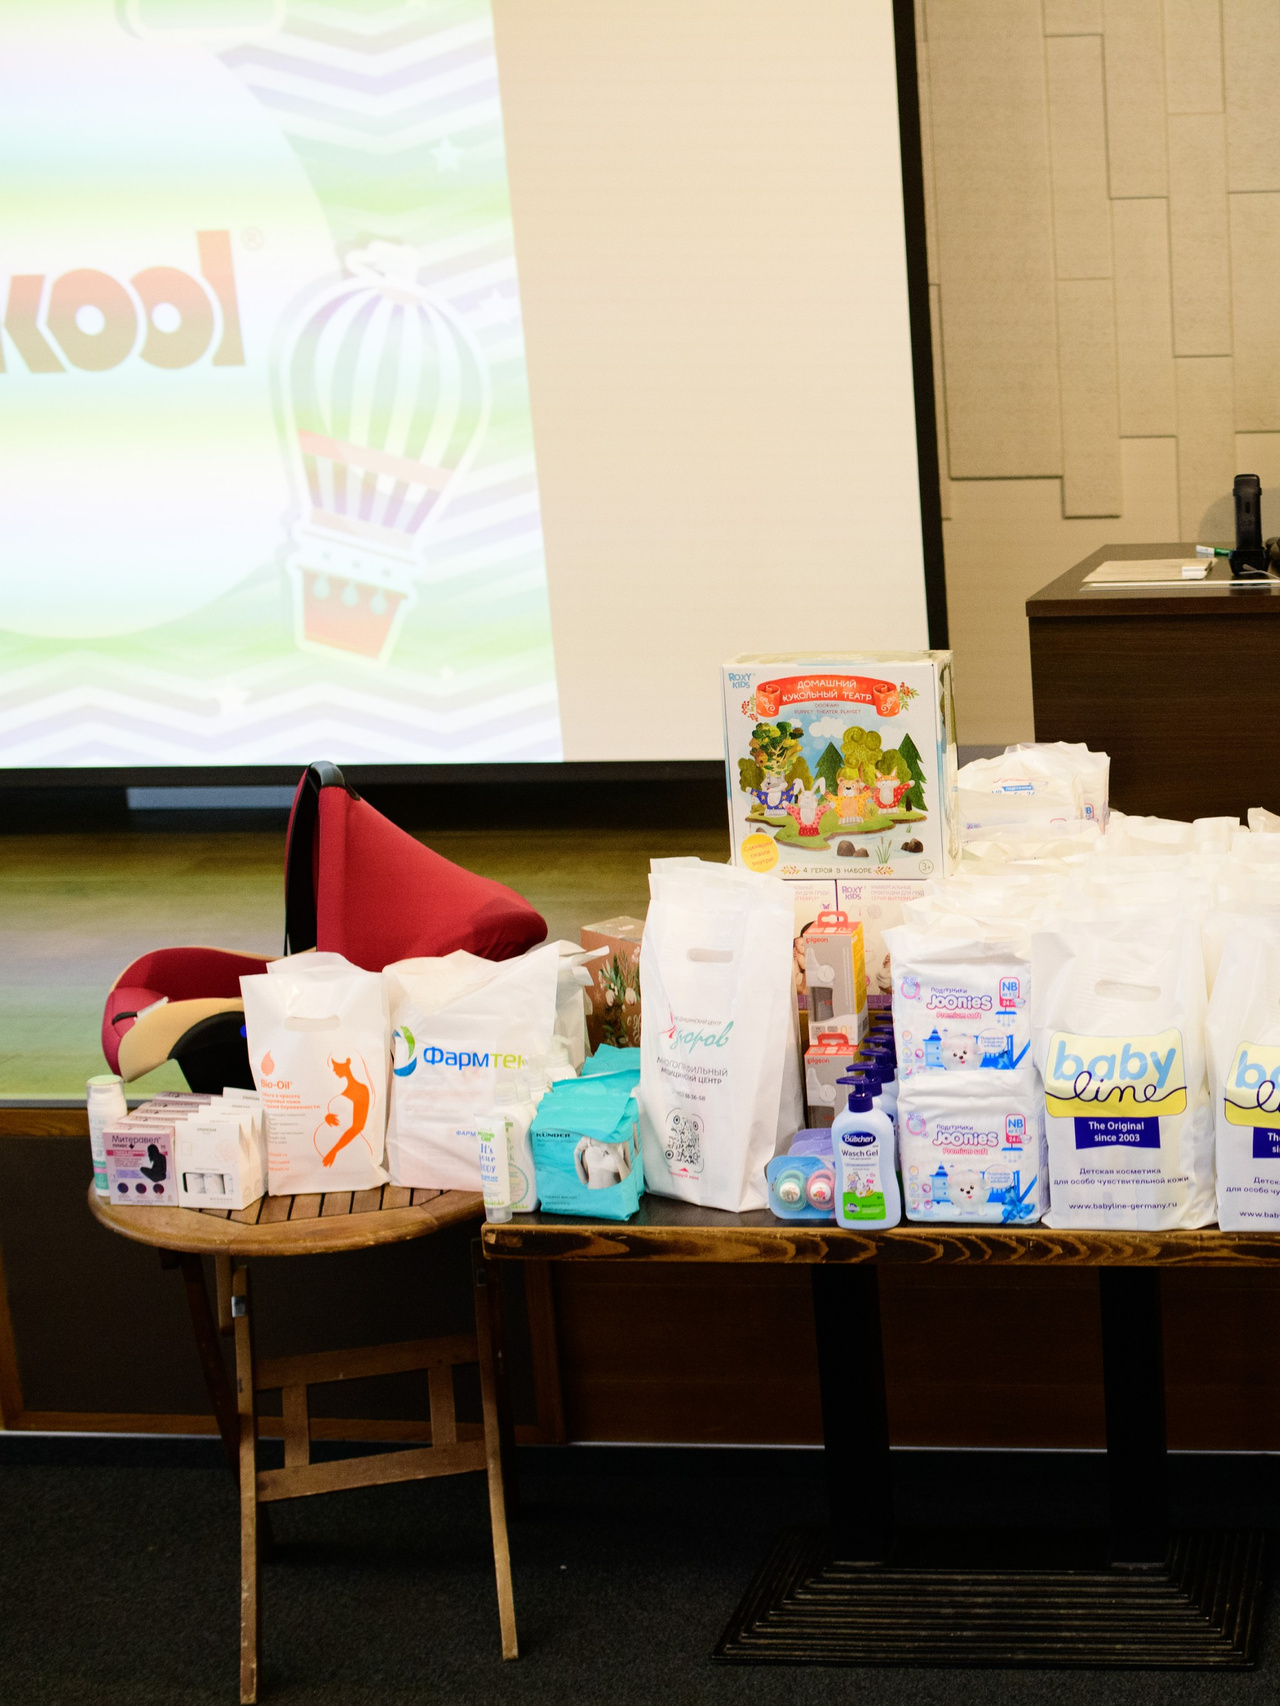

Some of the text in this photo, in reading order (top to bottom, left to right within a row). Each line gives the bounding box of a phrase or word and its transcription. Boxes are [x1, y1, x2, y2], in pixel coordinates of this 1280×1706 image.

[728, 673, 751, 682] ROXY
[732, 681, 750, 689] KIDS
[797, 679, 857, 689] ДОМАШНИЙ
[782, 690, 873, 702] КУКОЛЬНЫЙ ТЕАТР
[842, 886, 864, 894] ROXY
[1002, 981, 1018, 992] NB
[807, 1057, 830, 1065] pigeon
[1053, 1040, 1177, 1089] baby
[698, 1072, 723, 1085] ЦЕНТР
[260, 1079, 290, 1090] Bio-Oil
[1060, 1070, 1175, 1103] line
[1007, 1118, 1024, 1129] NB
[1088, 1121, 1144, 1132] The Original
[1094, 1133, 1140, 1142] since 2003
[841, 1148, 879, 1157] Wasch Gel
[1079, 1167, 1114, 1175] Детская
[1070, 1177, 1095, 1185] особо
[1097, 1176, 1165, 1186] чувствительной
[1243, 1186, 1269, 1194] особо
[1069, 1201, 1178, 1211] www.babyline-germany.ru
